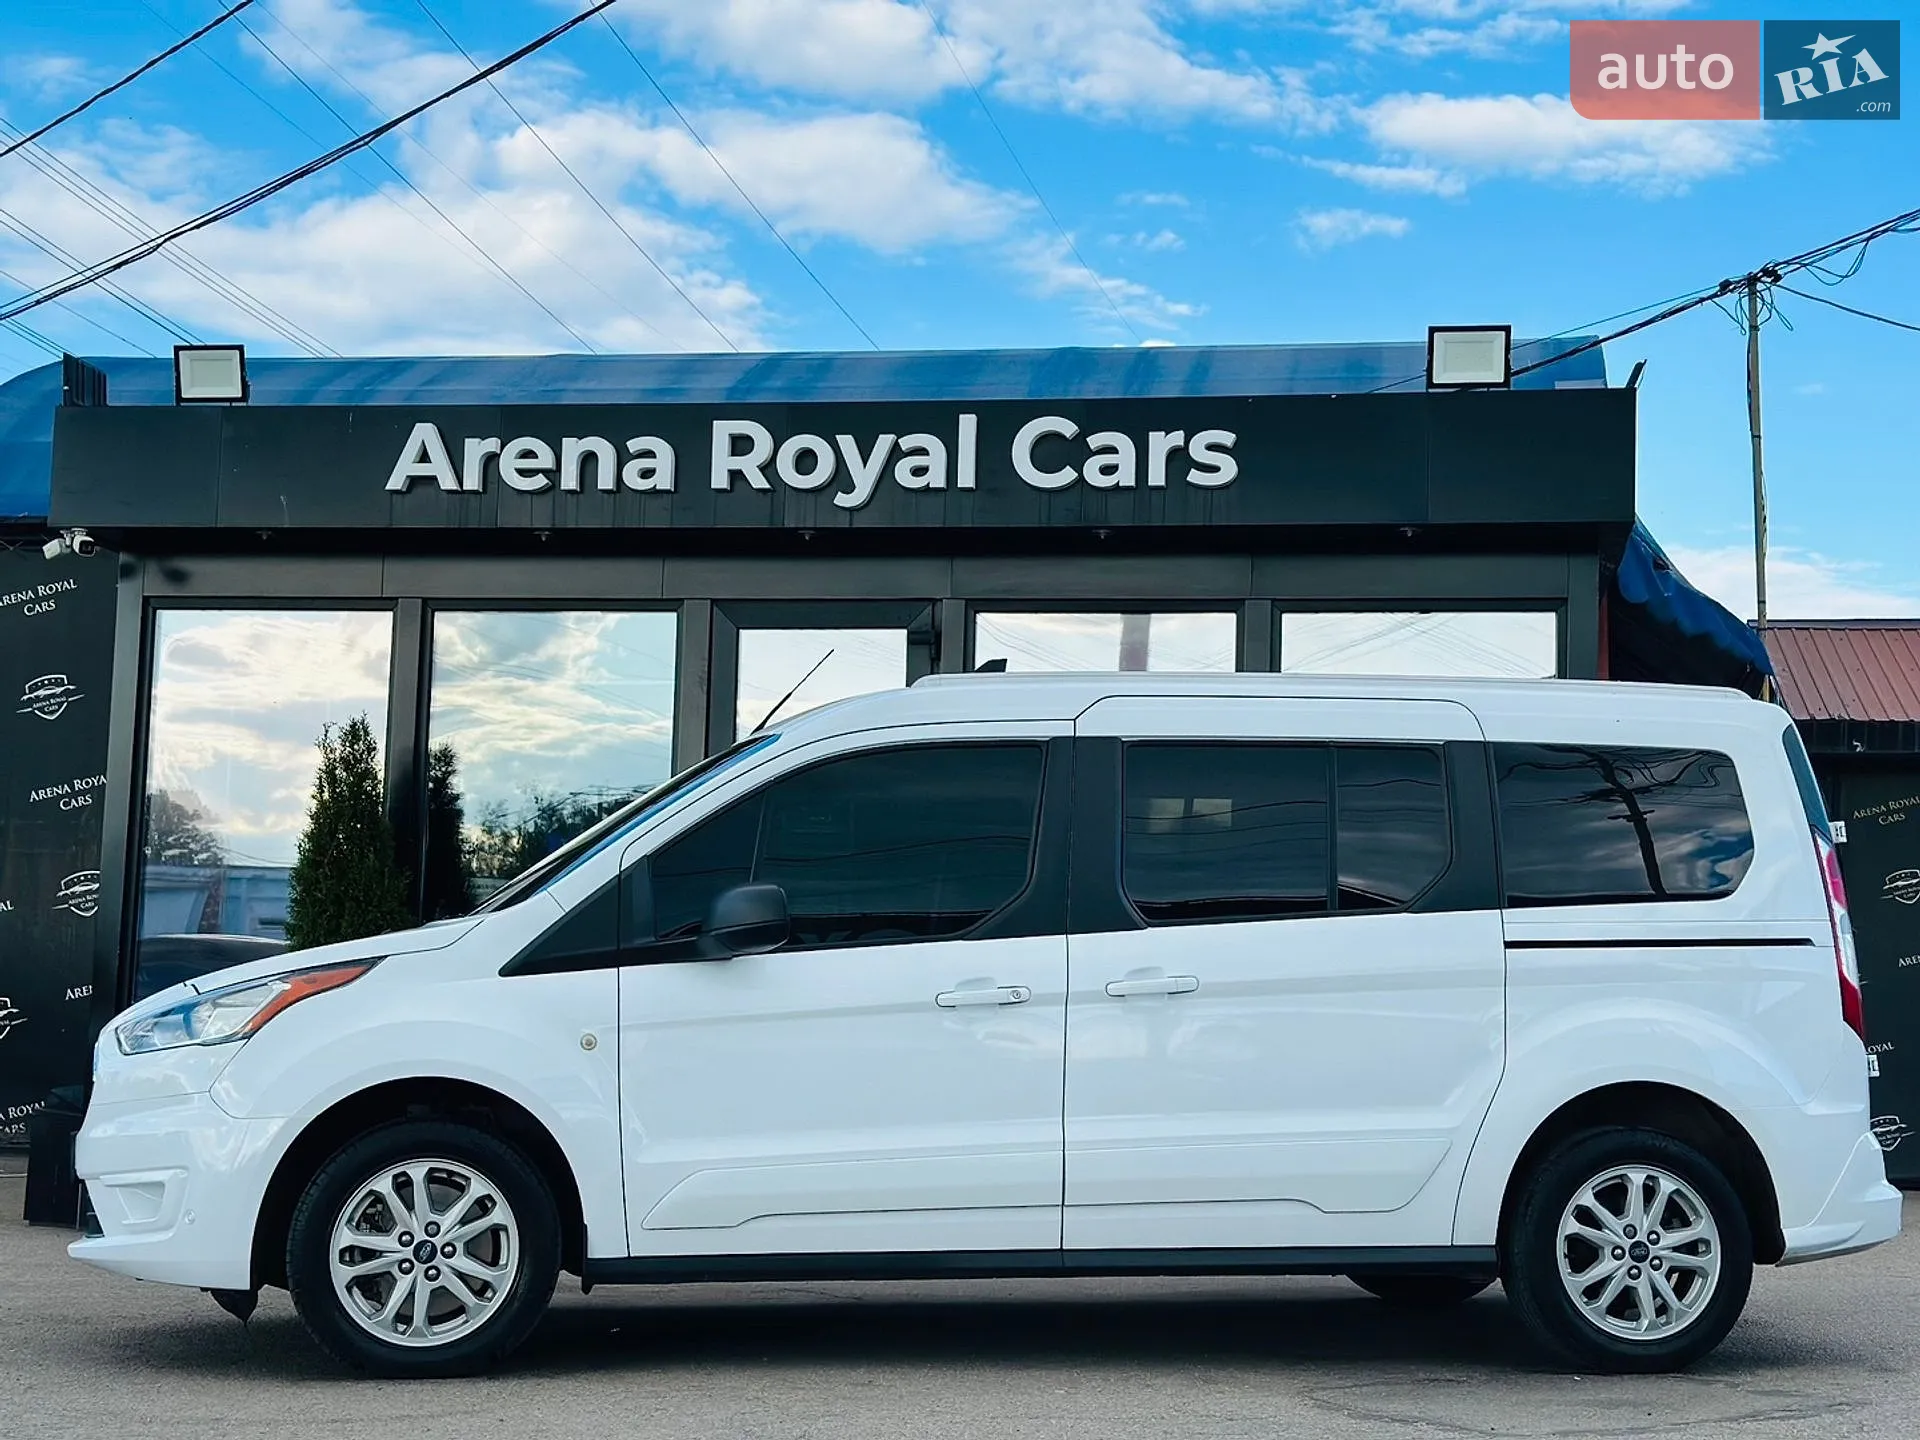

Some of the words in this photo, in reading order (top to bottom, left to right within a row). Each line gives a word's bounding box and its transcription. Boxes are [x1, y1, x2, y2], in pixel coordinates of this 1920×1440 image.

[385, 421, 676, 493] Arena
[710, 413, 978, 509] Royal
[1011, 415, 1240, 491] Cars
[37, 579, 78, 597] ROYAL
[23, 599, 56, 616] CARS
[29, 783, 72, 803] ARENA
[60, 793, 93, 811] CARS
[1853, 804, 1887, 819] ARENA
[1878, 812, 1906, 826] CARS
[1866, 1041, 1895, 1054] OYAL
